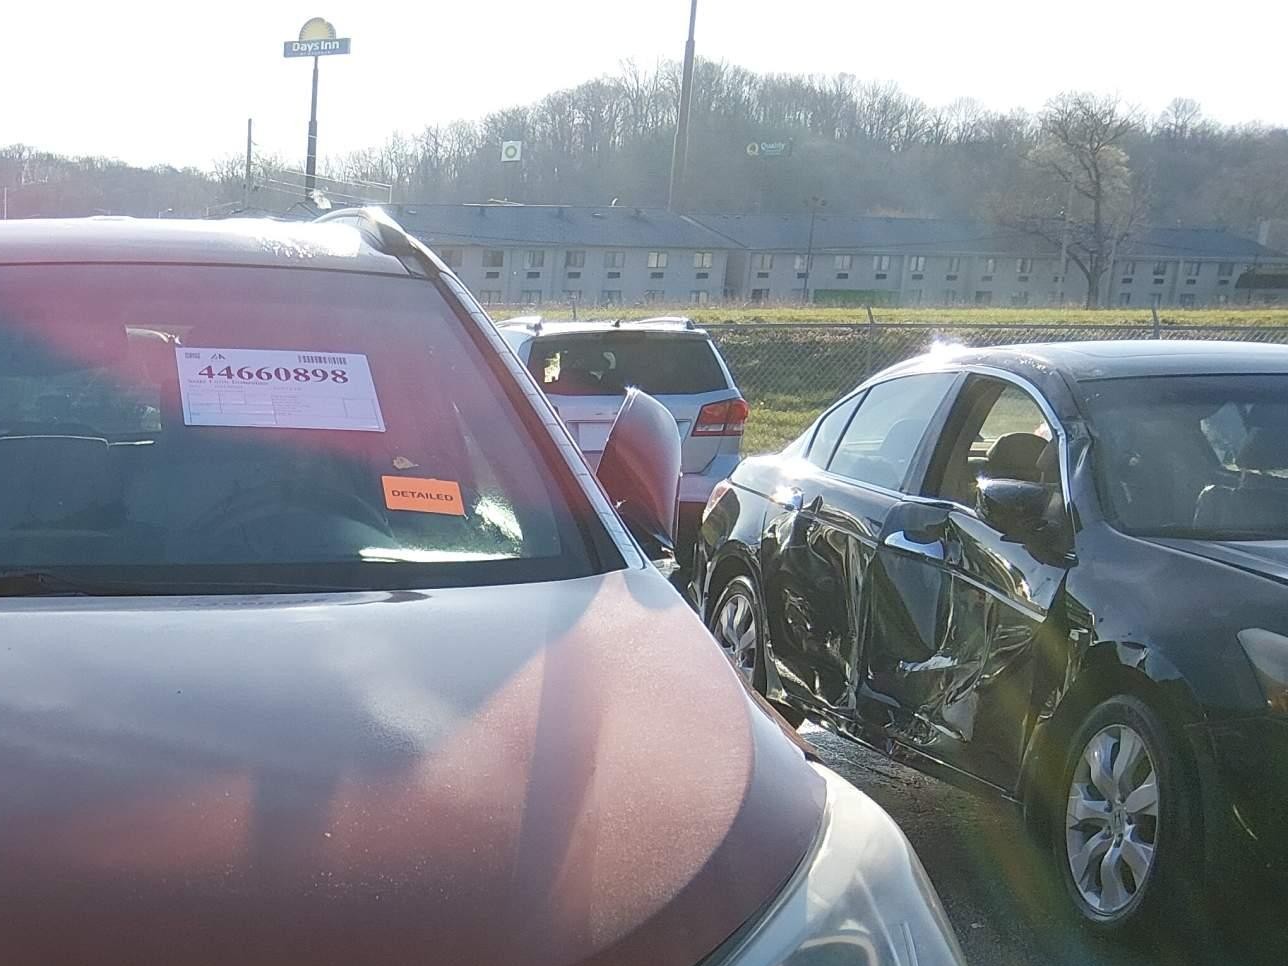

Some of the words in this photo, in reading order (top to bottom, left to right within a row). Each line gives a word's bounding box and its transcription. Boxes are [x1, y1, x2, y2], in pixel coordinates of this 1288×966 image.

[292, 41, 320, 53] Days
[321, 40, 340, 50] Inn
[198, 364, 349, 384] 44660898
[392, 489, 454, 502] DETAILED
